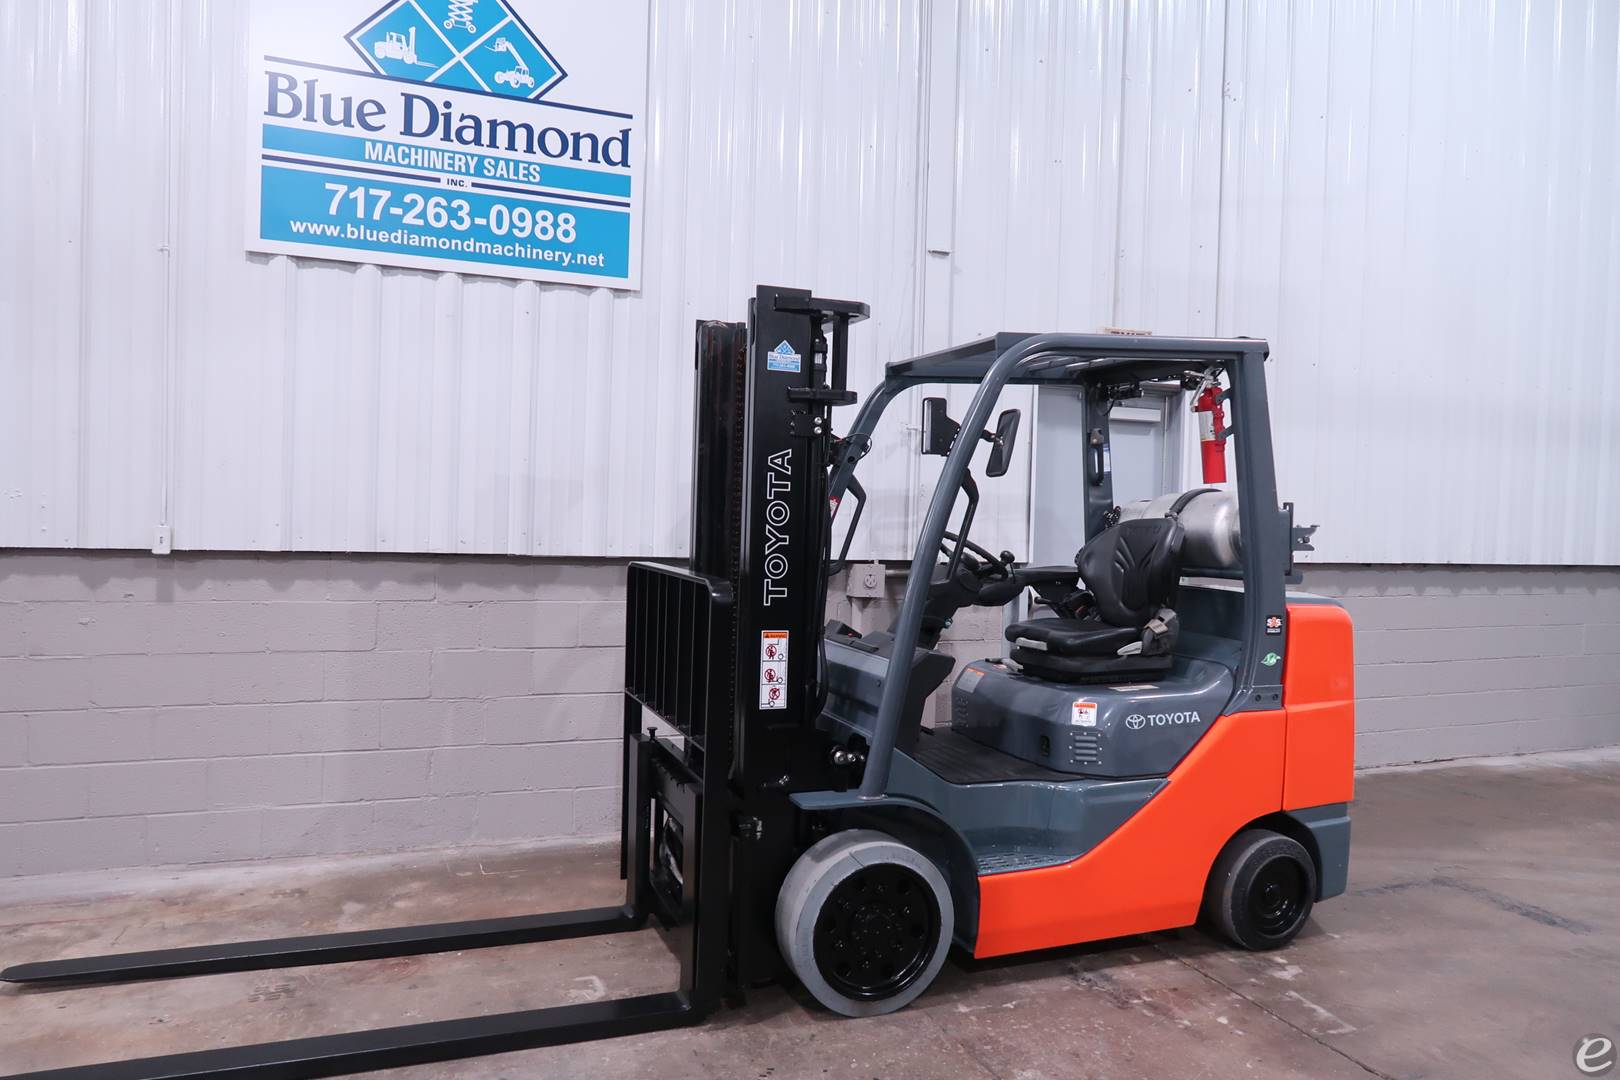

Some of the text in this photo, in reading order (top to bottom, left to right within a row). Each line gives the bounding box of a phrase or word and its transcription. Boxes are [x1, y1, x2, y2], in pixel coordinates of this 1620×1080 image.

[264, 70, 632, 168] Blue Diamond
[364, 140, 541, 184] MACHINERY SALES
[446, 178, 468, 188] INC.
[324, 182, 577, 244] 717-263-0988
[290, 218, 605, 268] www.bluediamondmachinery.net
[763, 449, 792, 606] TOYOTA
[1148, 711, 1200, 727] TOYOTA
